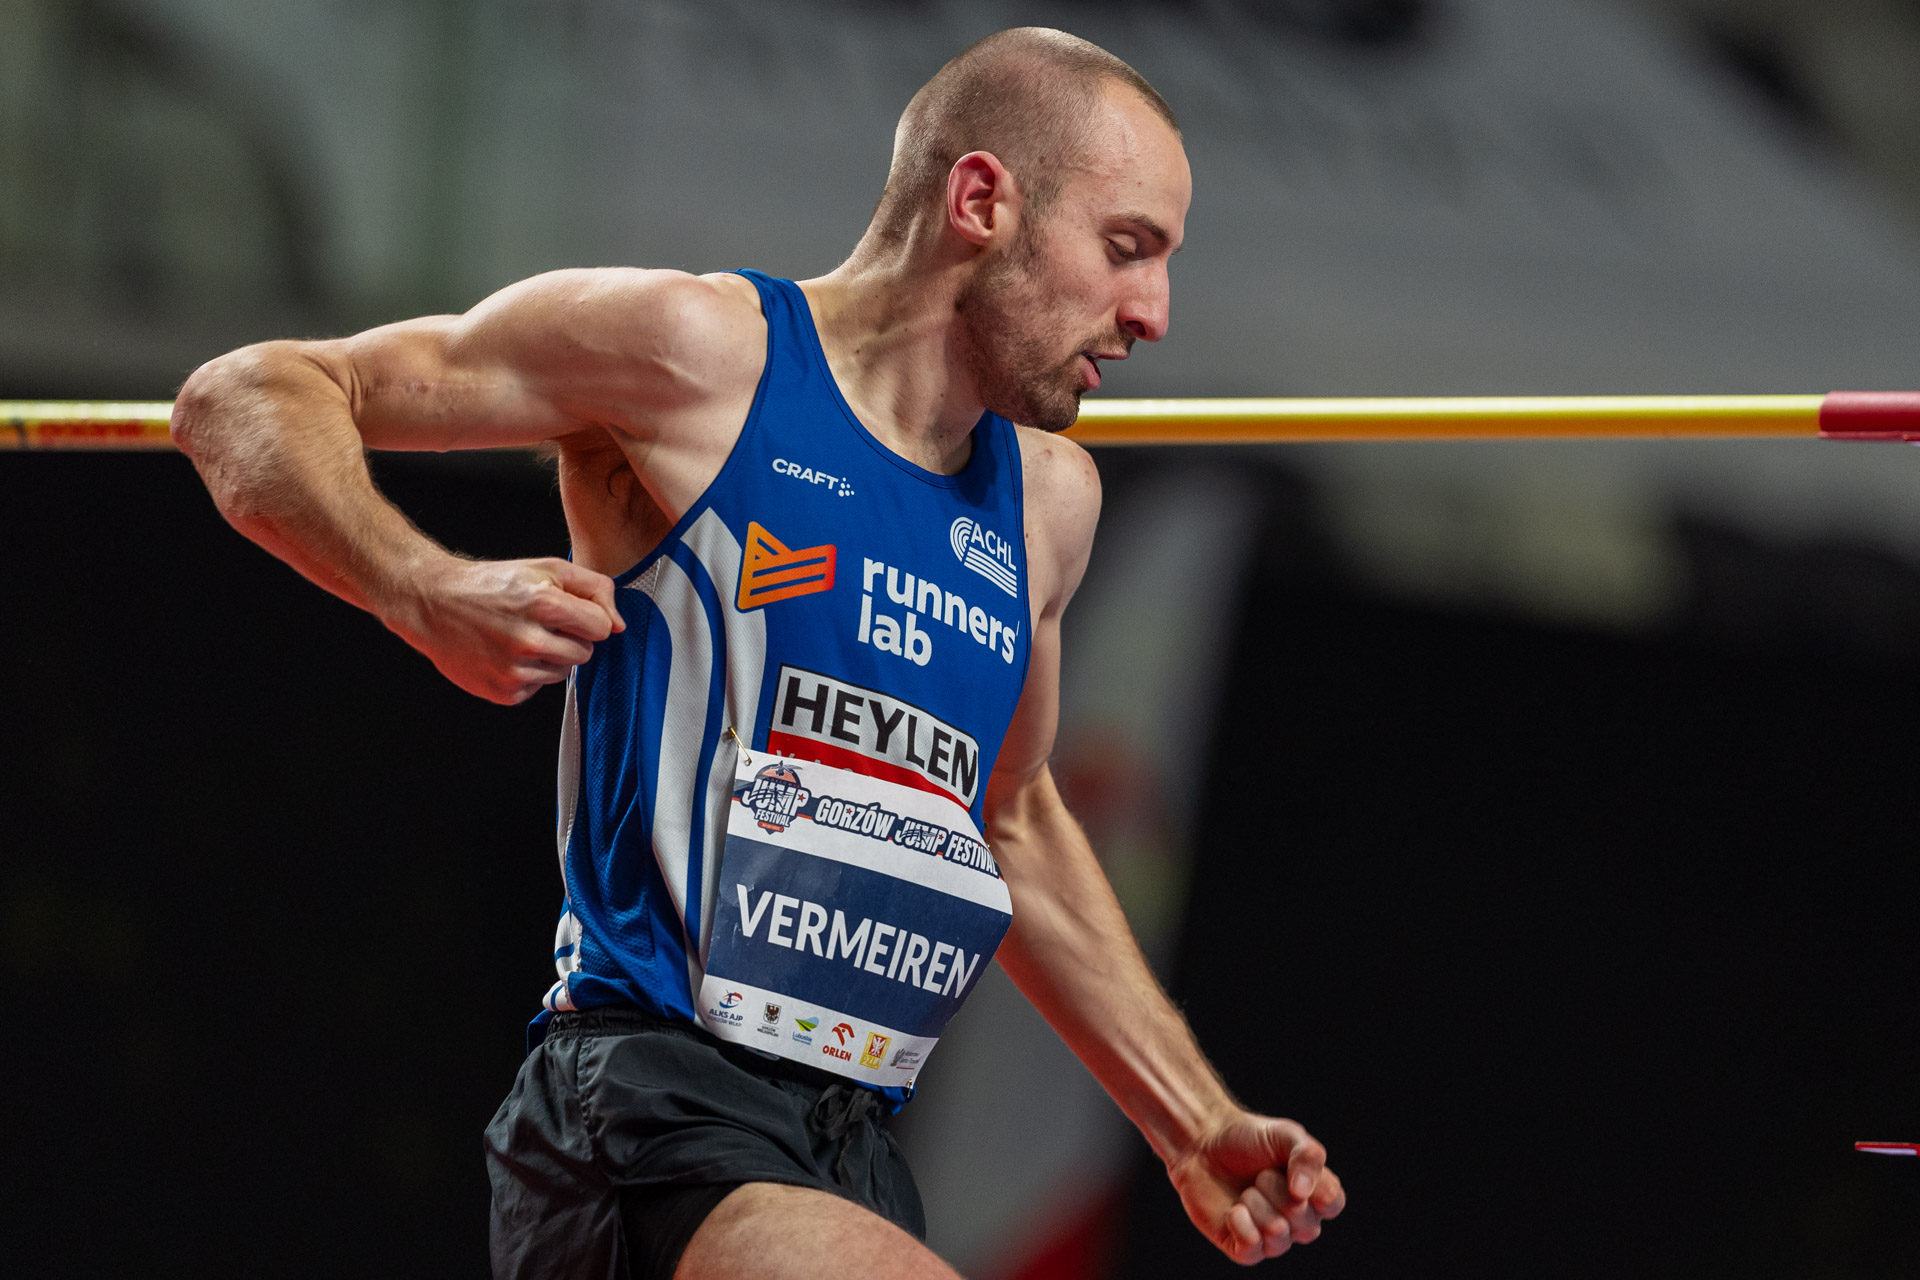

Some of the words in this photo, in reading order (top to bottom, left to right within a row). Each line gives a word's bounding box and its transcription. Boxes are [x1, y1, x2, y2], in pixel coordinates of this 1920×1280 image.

[772, 458, 838, 490] CRAFT
[970, 522, 1017, 572] ACHL
[858, 594, 933, 667] lab
[781, 676, 977, 798] HEYLEN
[755, 809, 790, 827] FESTIVAL
[815, 798, 896, 839] GORZÓW
[945, 834, 999, 876] FESTIVAL
[736, 883, 981, 999] VERMEIREN
[709, 1008, 729, 1019] ALKS
[730, 1013, 743, 1022] AJP
[822, 1045, 852, 1062] ORLEN
